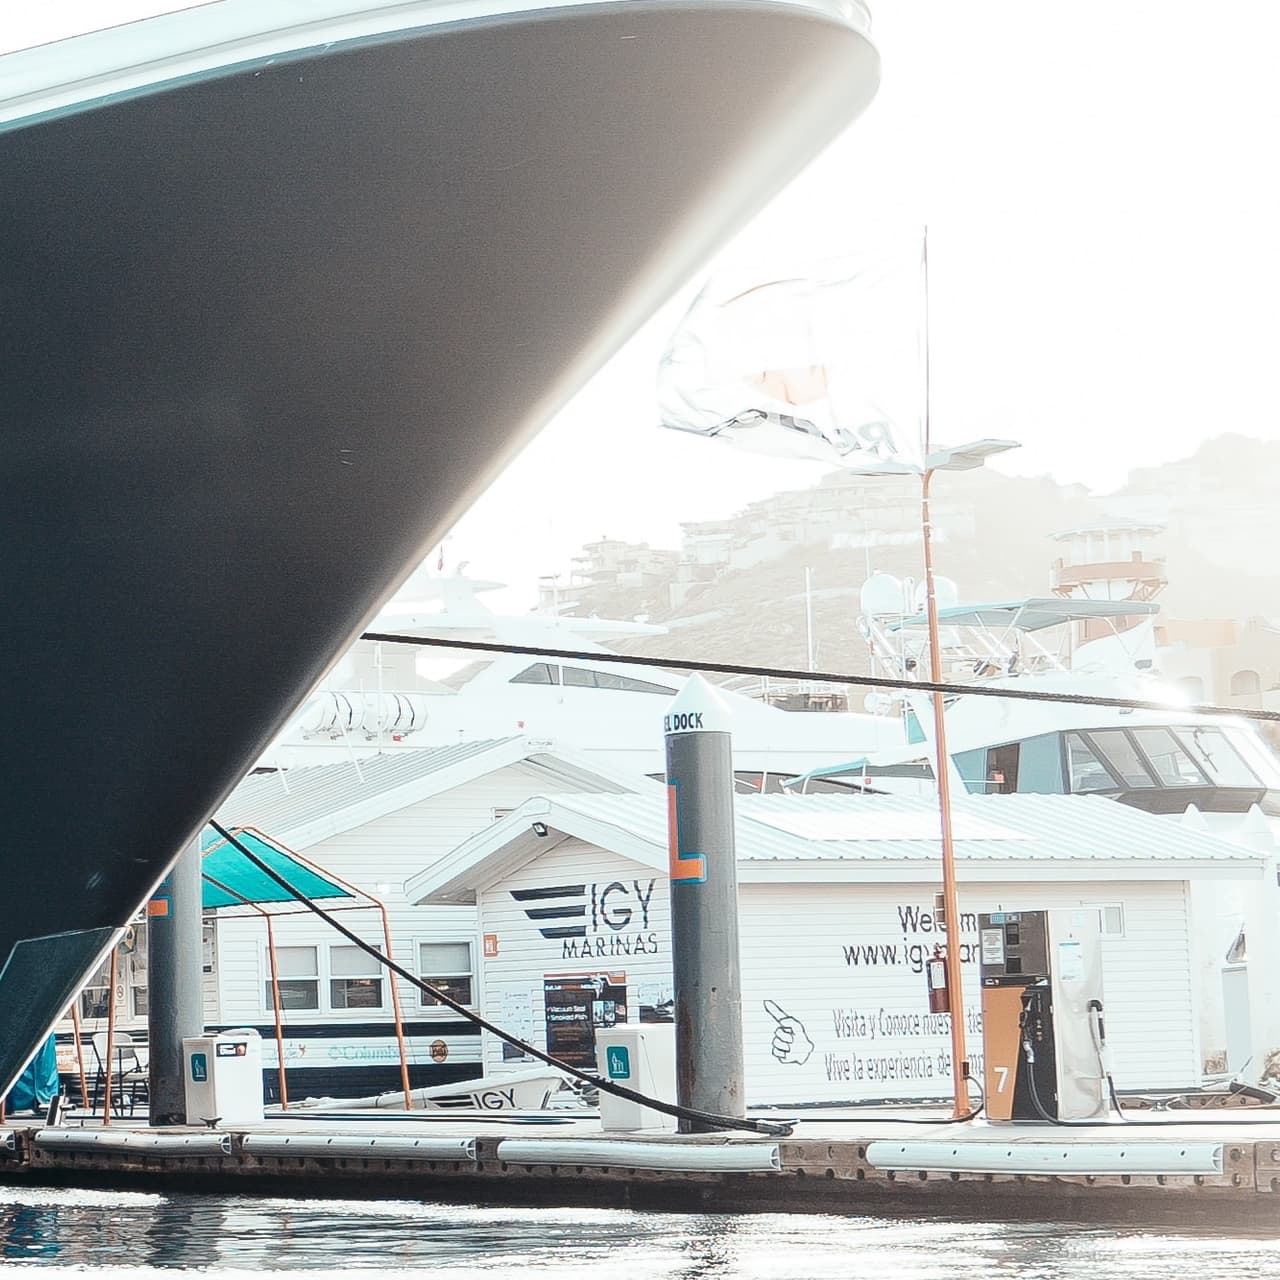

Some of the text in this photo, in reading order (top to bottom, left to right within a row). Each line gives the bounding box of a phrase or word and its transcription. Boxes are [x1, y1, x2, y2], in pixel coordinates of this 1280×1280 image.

[674, 712, 704, 731] DOCK
[592, 878, 656, 932] IGY
[898, 906, 977, 933] Welm
[562, 933, 658, 959] MARINAS
[843, 937, 980, 973] www.igar
[833, 1008, 867, 1038] Visita
[870, 1014, 876, 1040] y
[880, 1008, 920, 1036] Conoce
[923, 1013, 952, 1036] nues
[824, 1052, 850, 1081] Vive
[853, 1052, 864, 1080] la
[867, 1051, 933, 1083] experiencia
[992, 1066, 1009, 1093] 7
[474, 1088, 516, 1110] IGY
